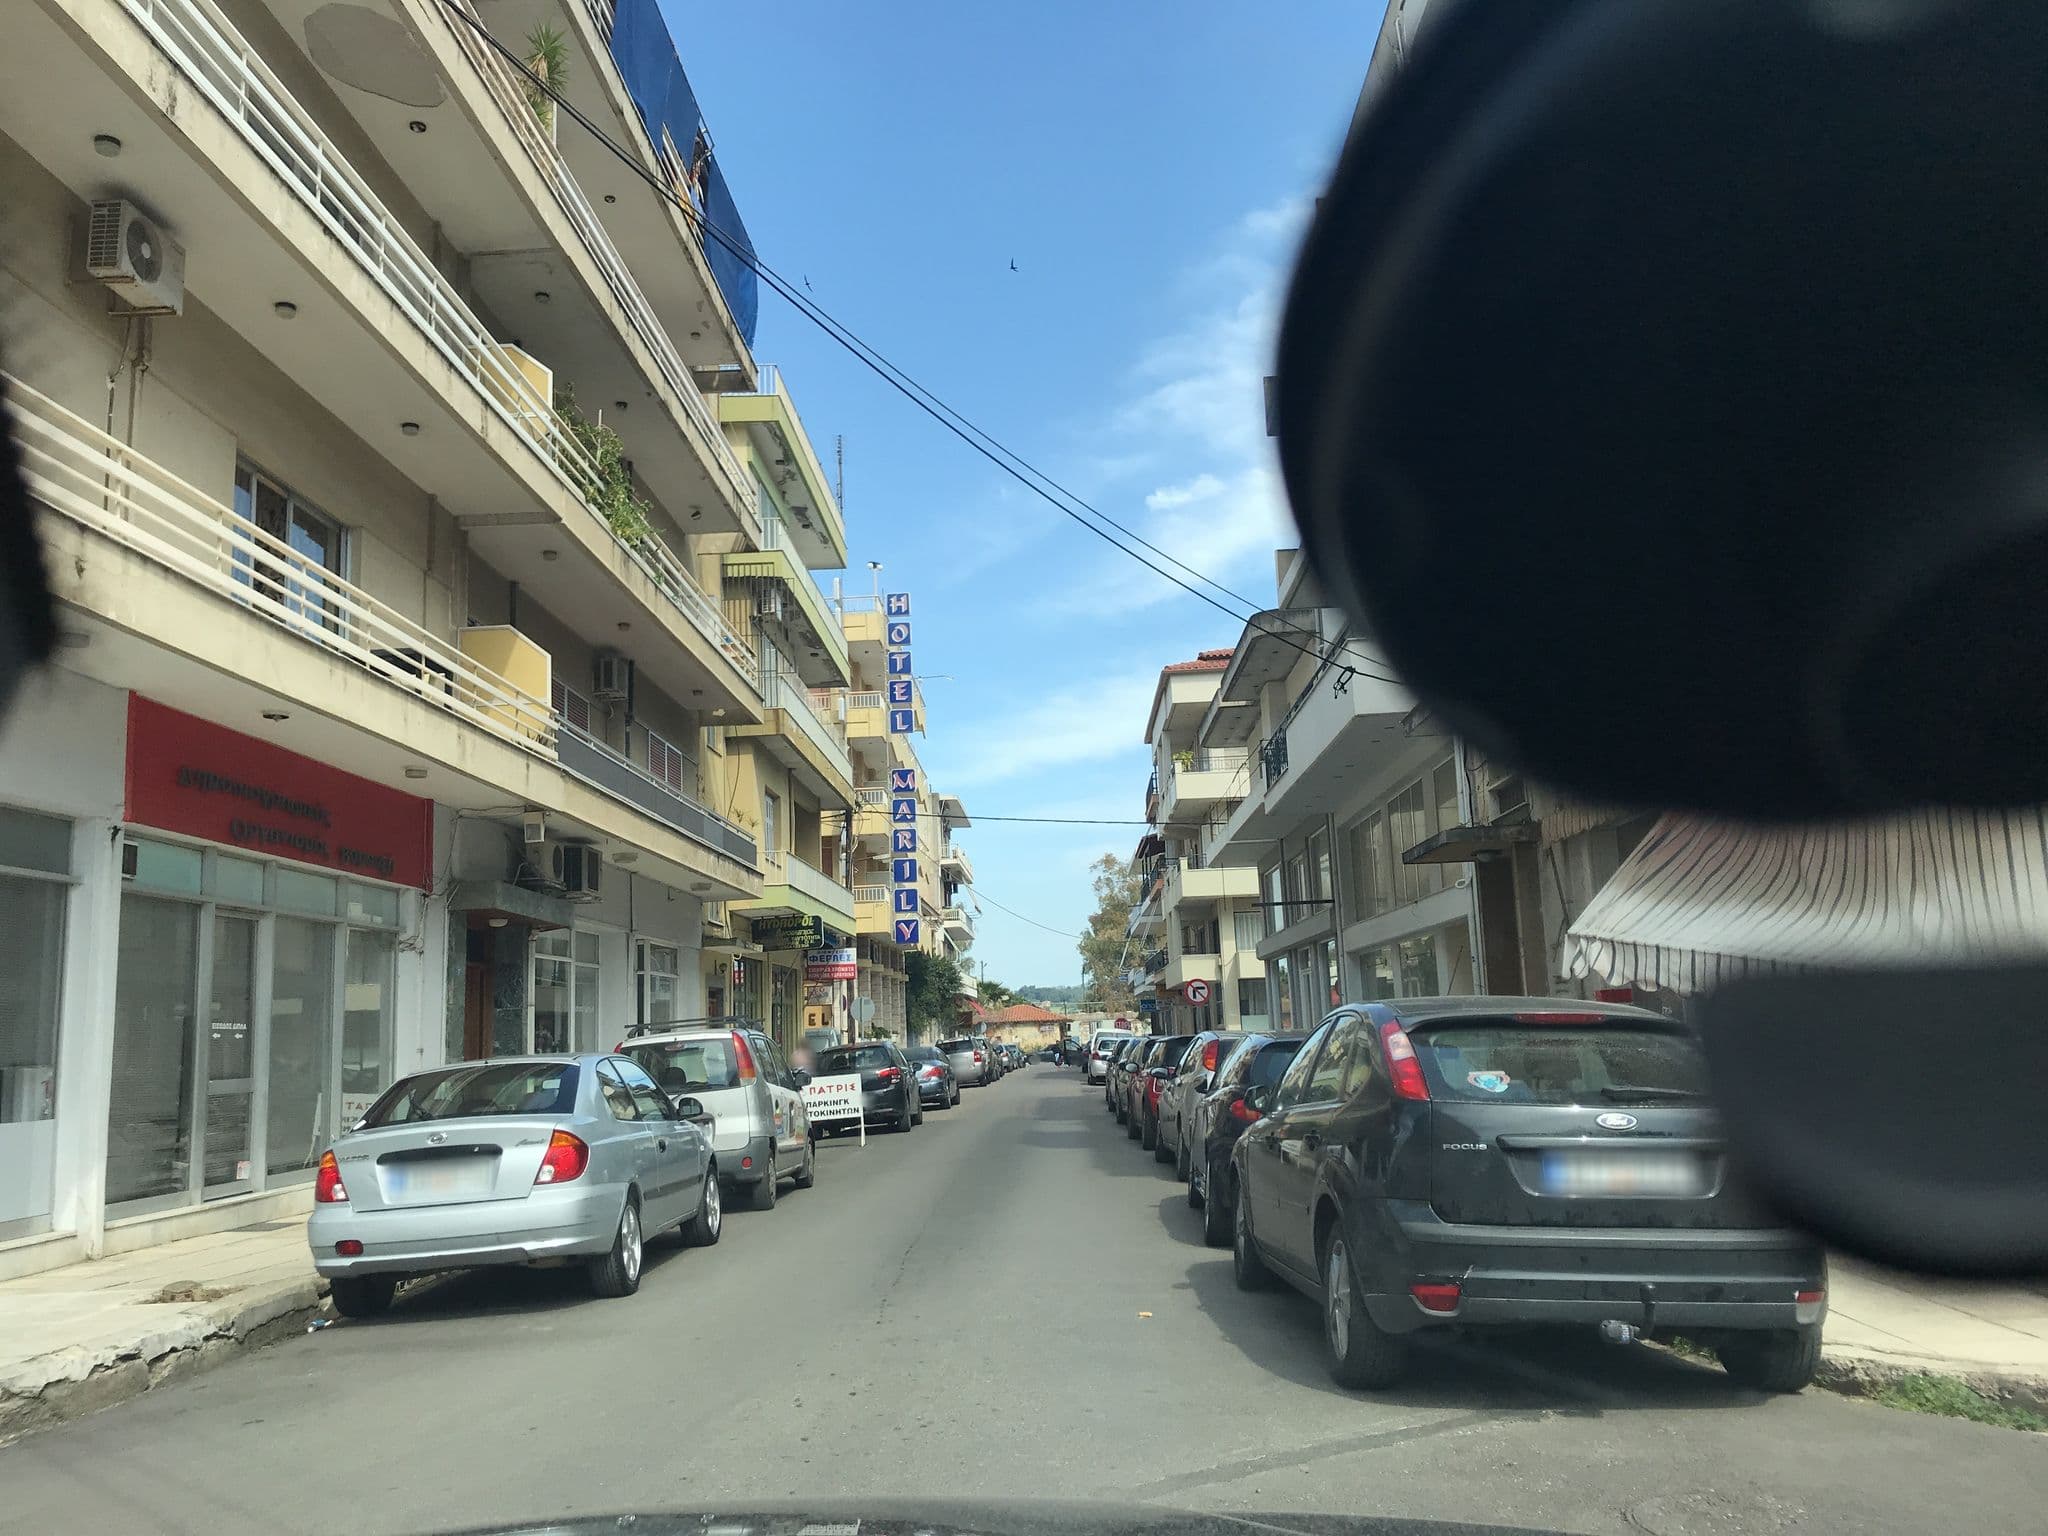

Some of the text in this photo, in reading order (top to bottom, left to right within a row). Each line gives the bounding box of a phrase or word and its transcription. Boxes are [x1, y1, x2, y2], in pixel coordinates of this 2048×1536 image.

[889, 594, 917, 941] HOTEL MARILY
[809, 1083, 856, 1095] ΠΑΤΡΙΣ
[808, 1107, 860, 1117] ΤΟΚΙΝΗΤΩΝ
[1442, 1143, 1488, 1151] FOCUS
